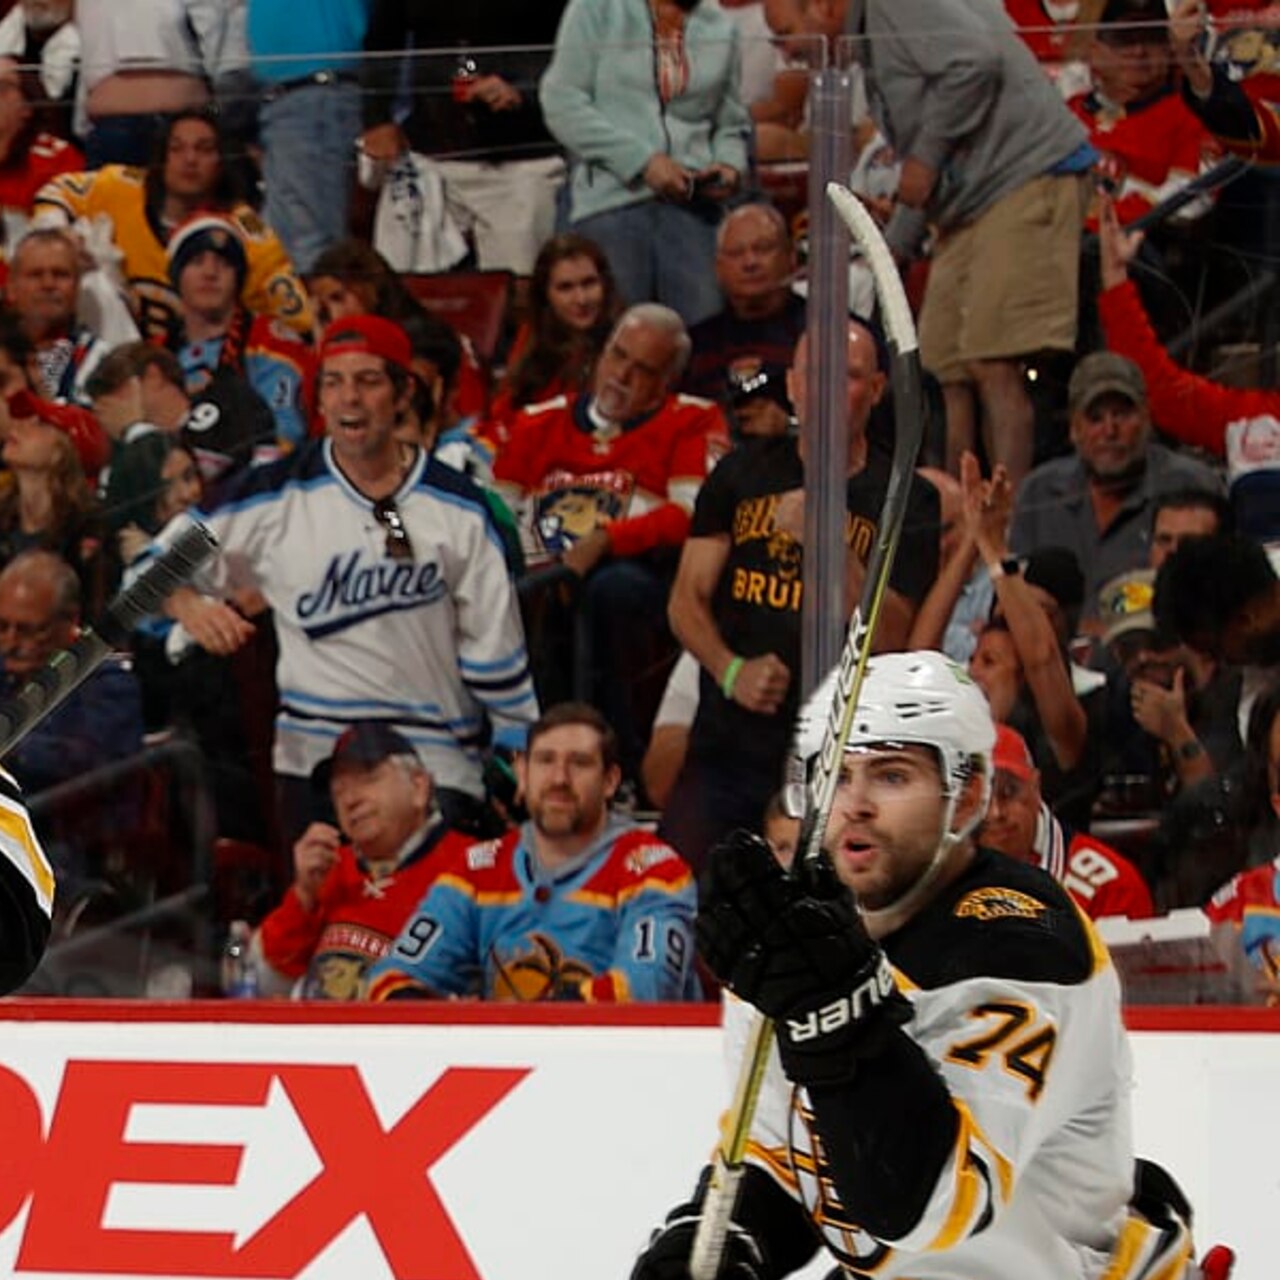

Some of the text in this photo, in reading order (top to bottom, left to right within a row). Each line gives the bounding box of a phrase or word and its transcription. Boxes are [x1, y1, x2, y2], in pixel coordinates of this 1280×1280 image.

[732, 567, 803, 611] BRUI
[1065, 847, 1119, 900] 19
[633, 916, 688, 977] 19
[945, 999, 1058, 1108] 74
